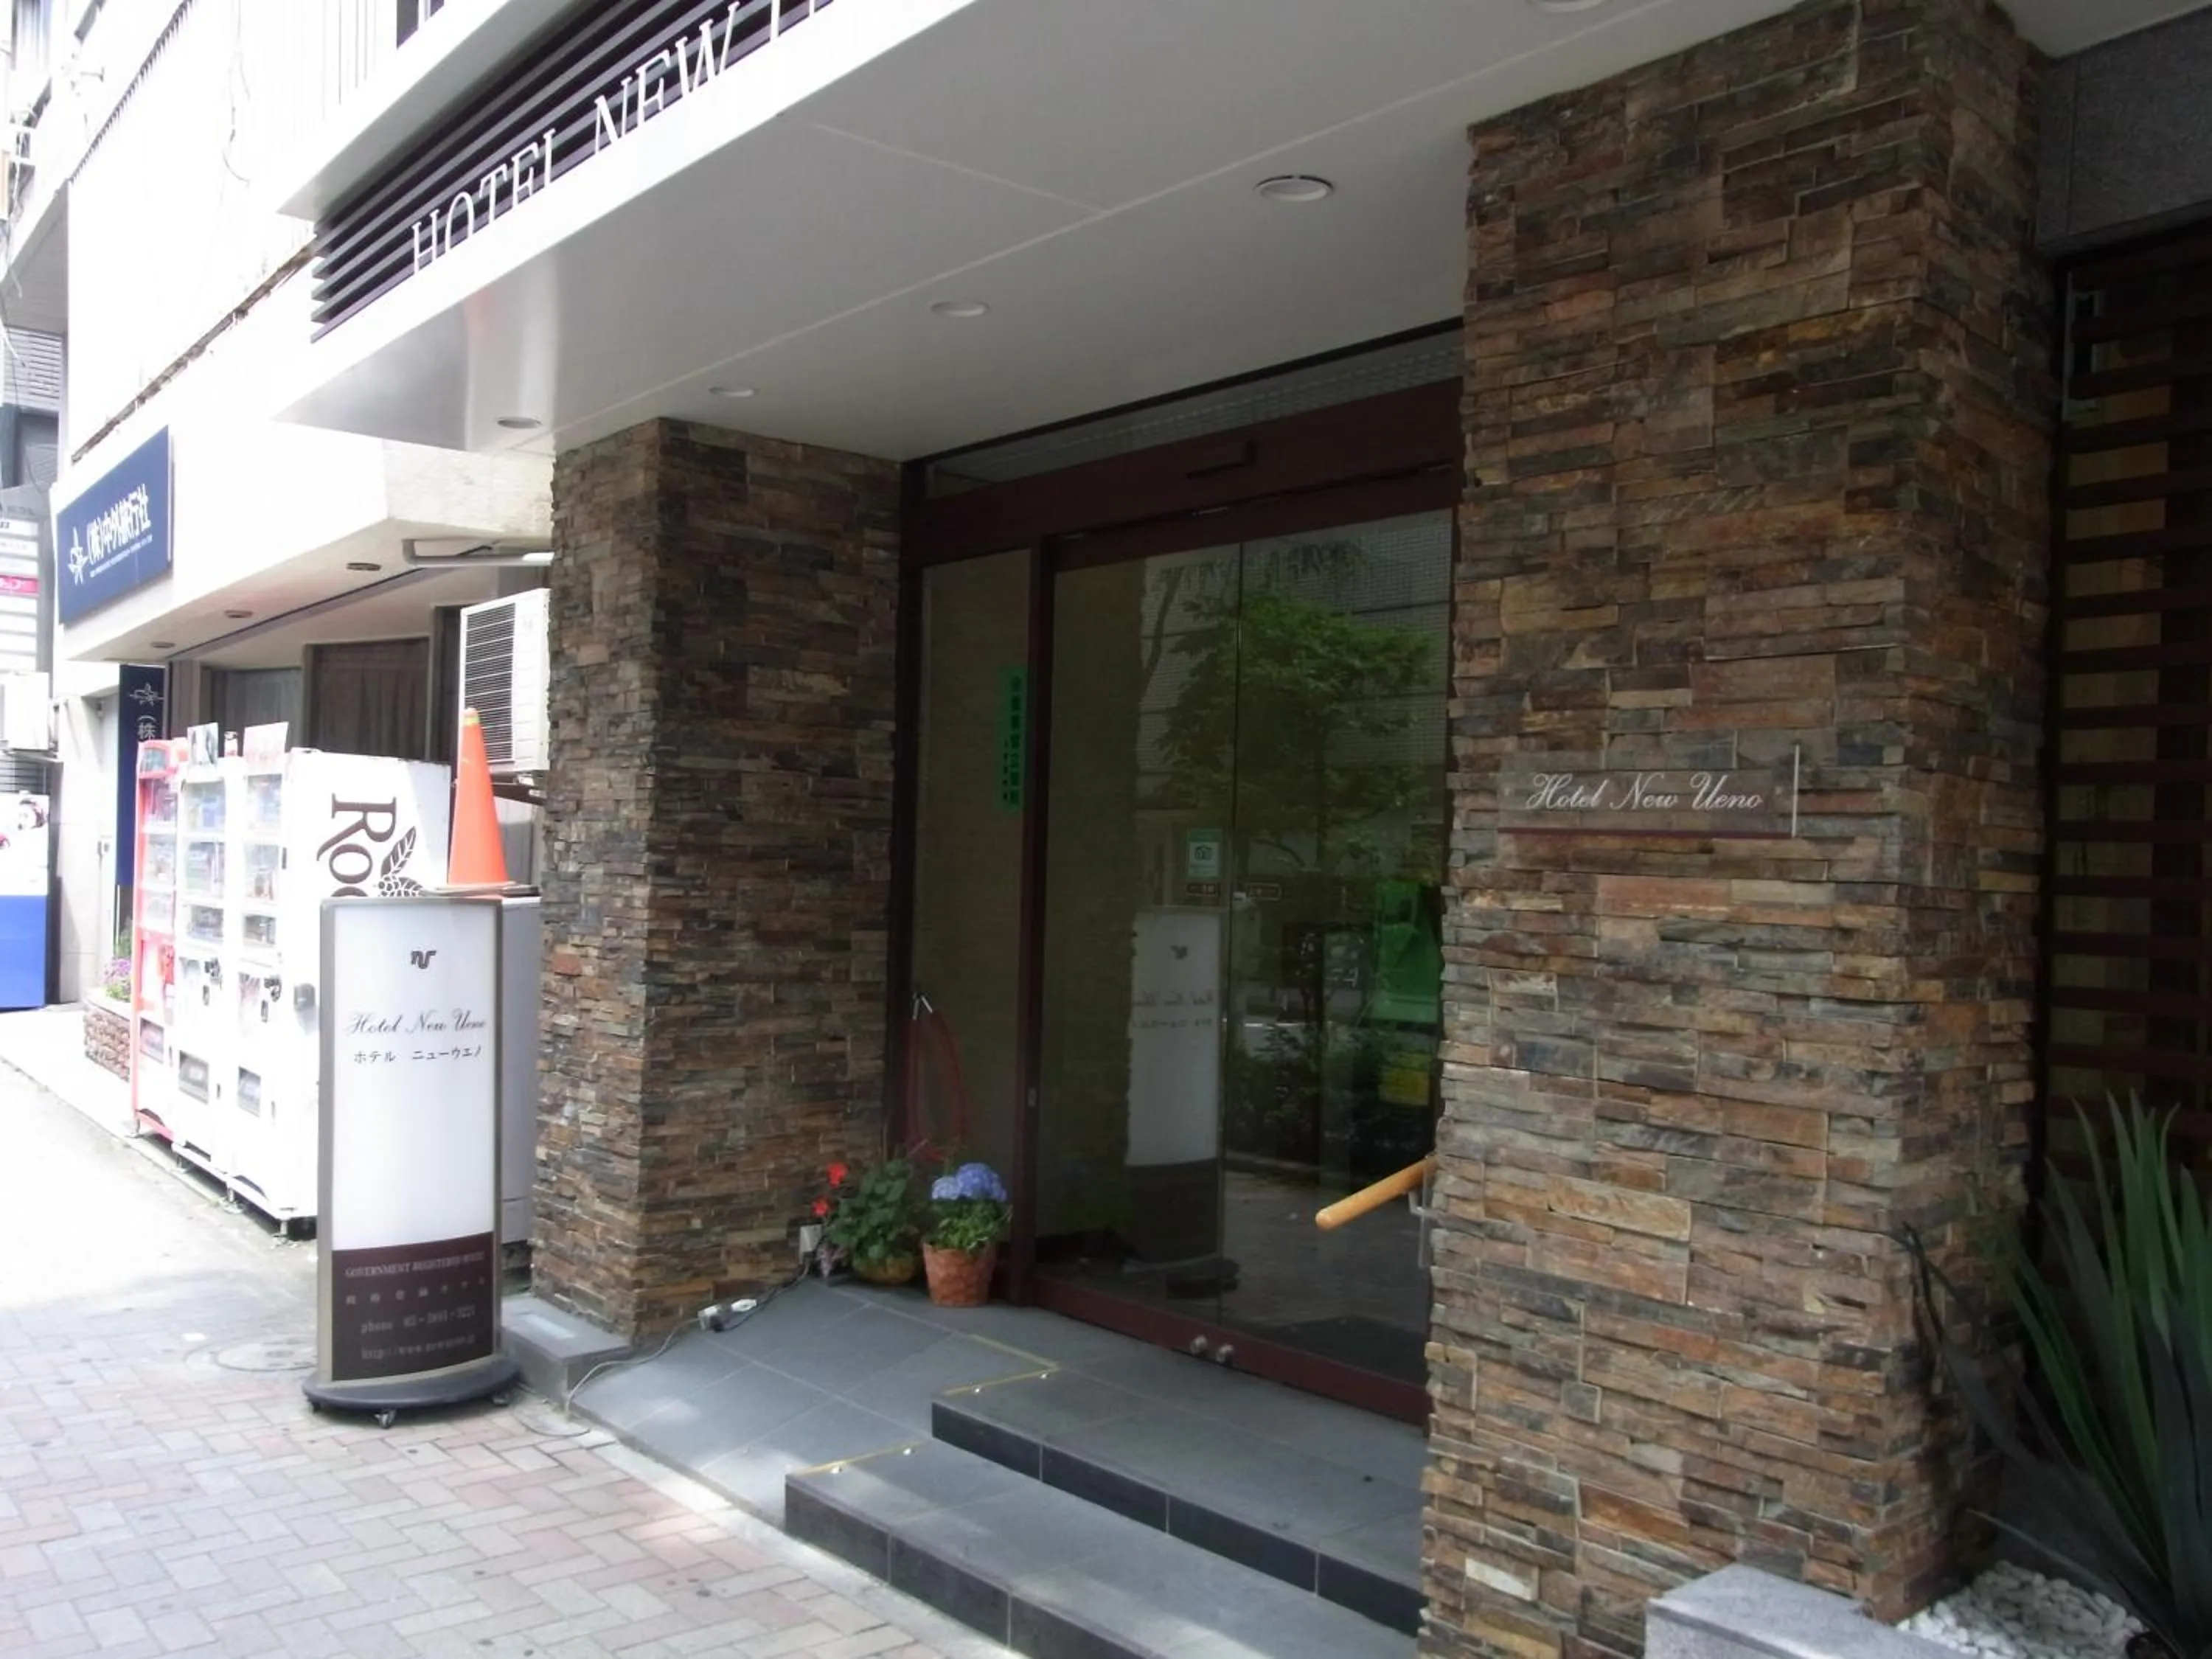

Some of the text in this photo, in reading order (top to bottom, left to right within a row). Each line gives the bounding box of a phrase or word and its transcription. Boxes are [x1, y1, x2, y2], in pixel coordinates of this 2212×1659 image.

[594, 1, 738, 156] NEW
[1526, 771, 1764, 811] Hotel New Ueno
[346, 1009, 403, 1034] Hotel
[405, 1009, 447, 1034] New
[354, 1050, 396, 1065] ホテル
[344, 1262, 411, 1278] GOVERNMENT
